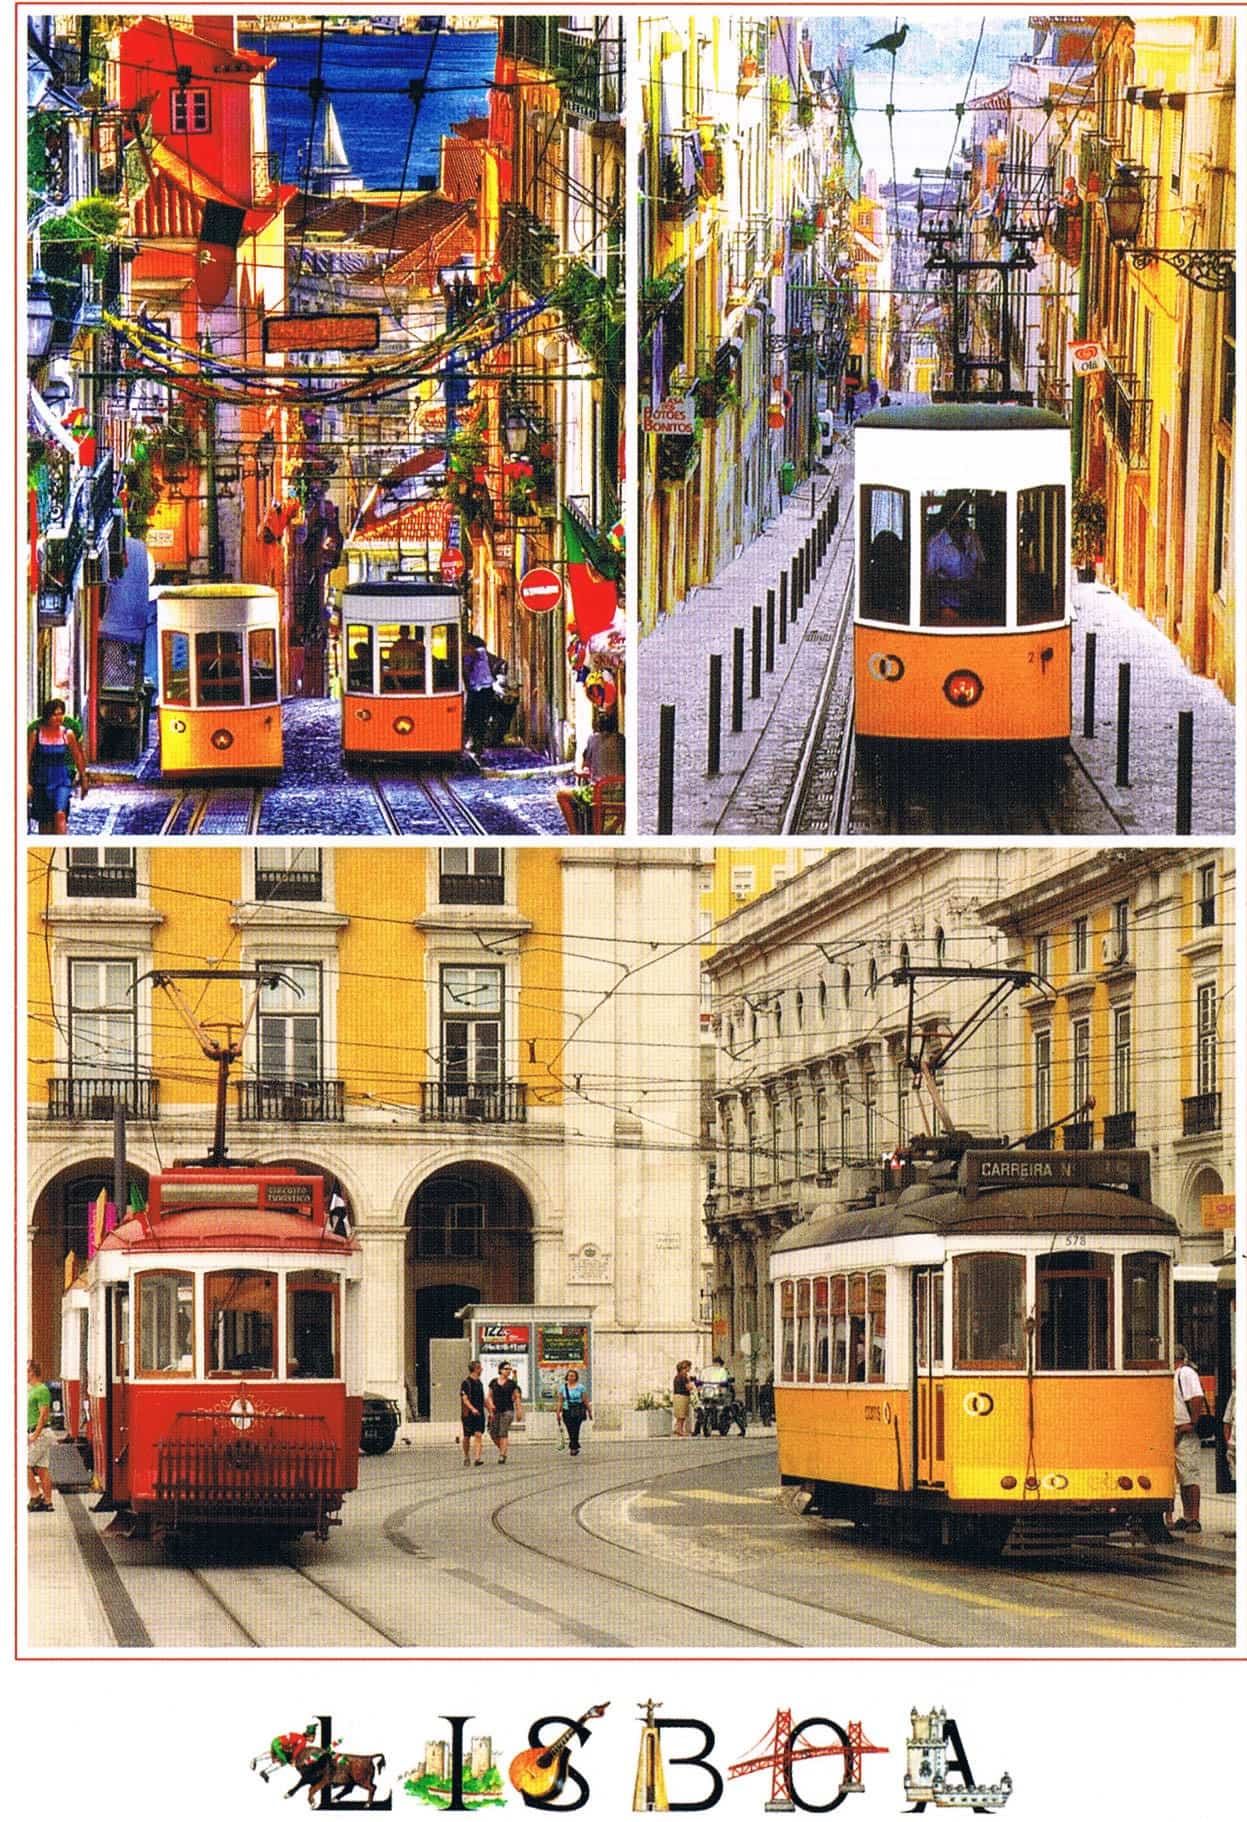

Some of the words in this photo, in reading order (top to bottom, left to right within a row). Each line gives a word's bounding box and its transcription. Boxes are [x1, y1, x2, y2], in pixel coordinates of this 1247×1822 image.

[643, 419, 693, 432] BONITOS
[981, 1162, 1053, 1177] CARREIRA
[1065, 1233, 1087, 1246] 578
[312, 1715, 997, 1813] LISBOA
